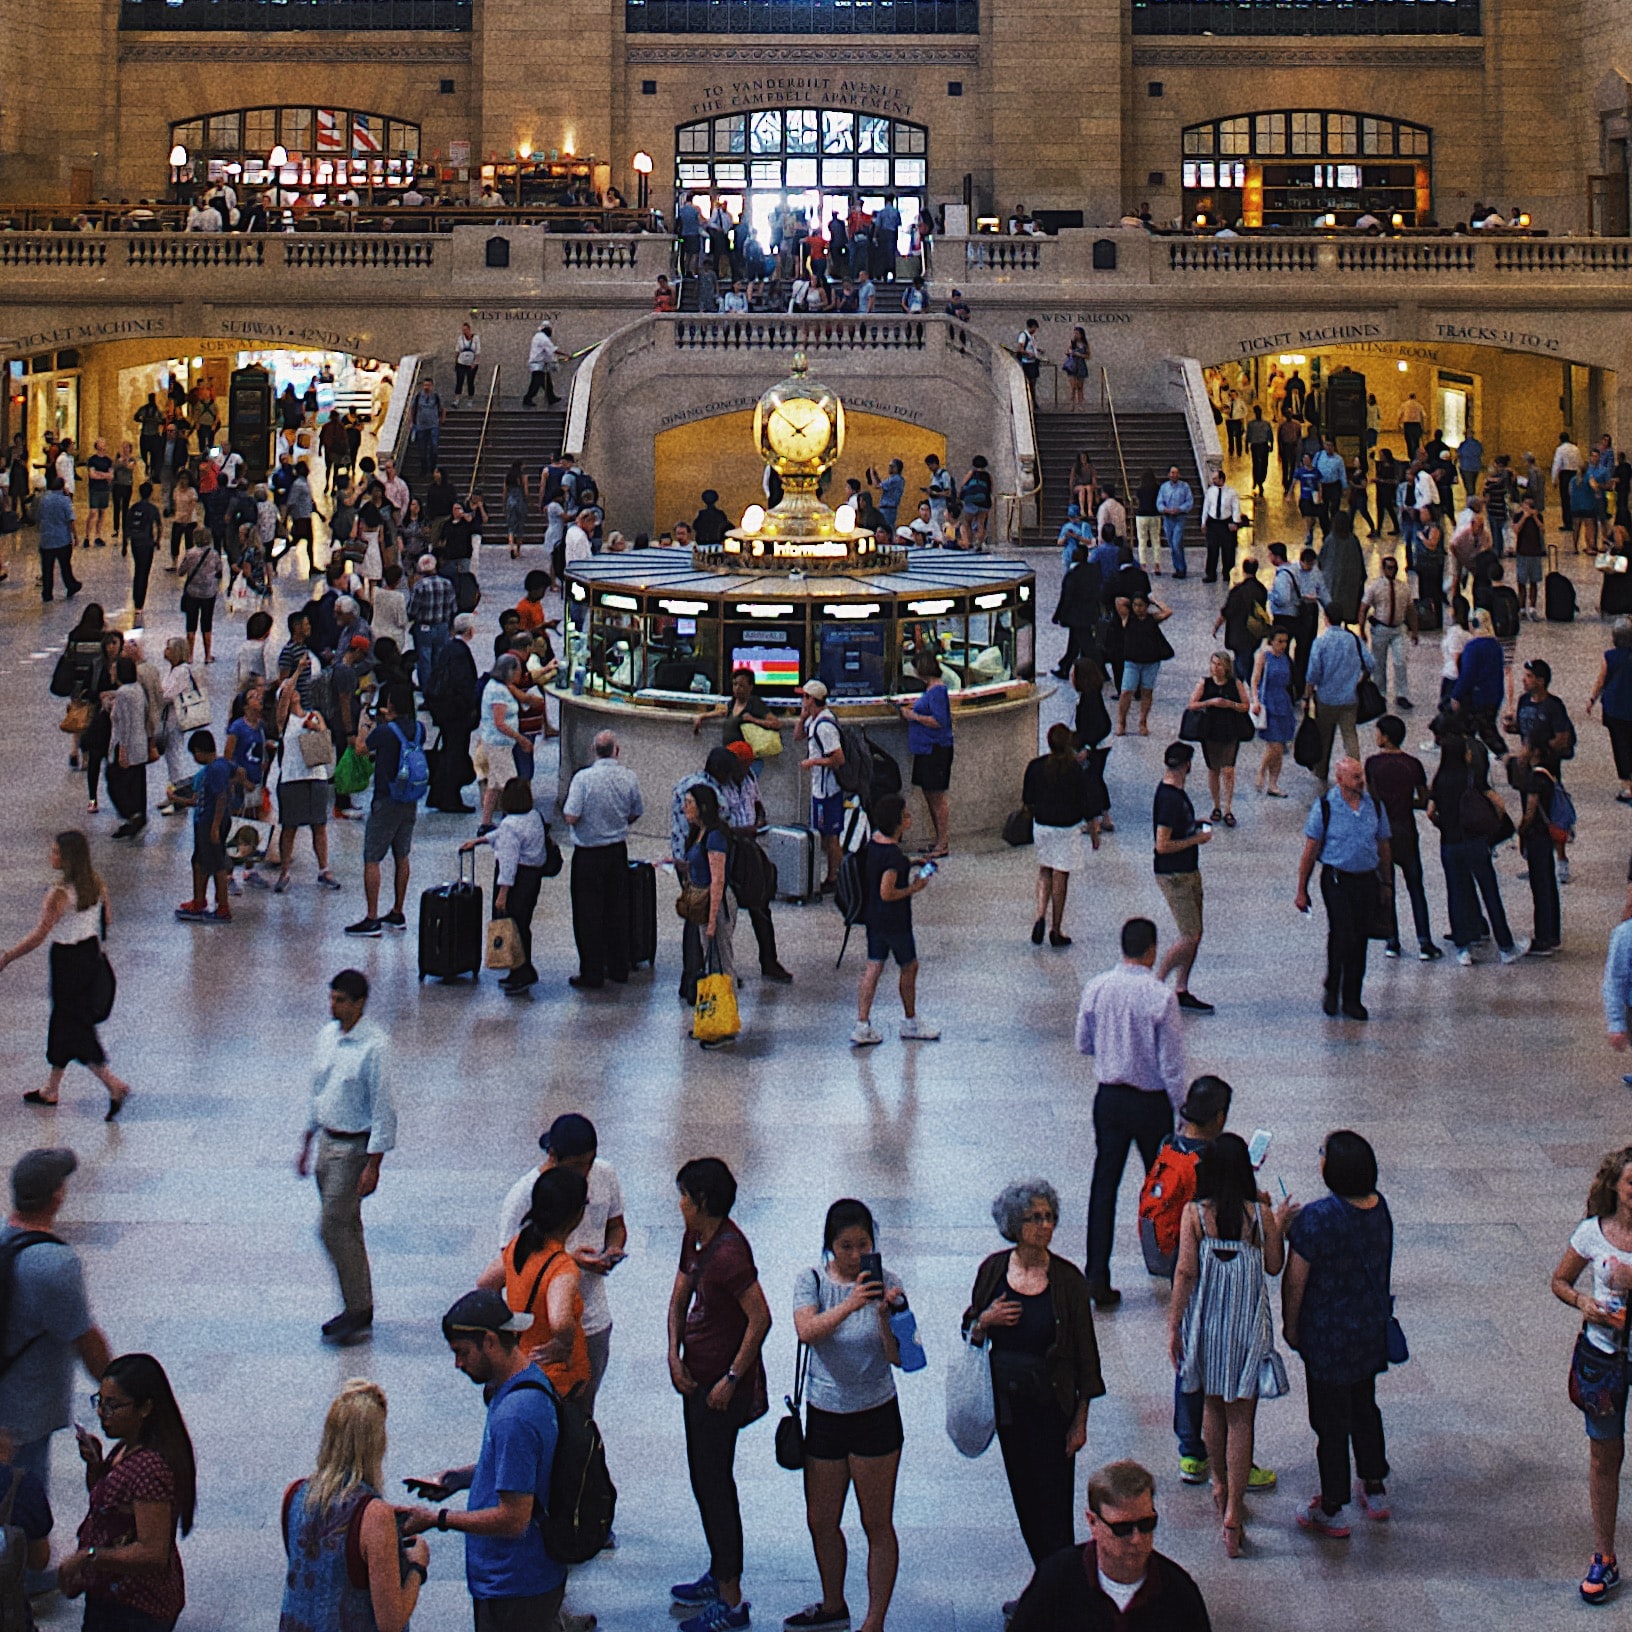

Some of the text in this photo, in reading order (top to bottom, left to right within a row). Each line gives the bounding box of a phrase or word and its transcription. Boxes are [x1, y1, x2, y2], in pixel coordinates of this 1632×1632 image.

[703, 77, 903, 99] TO VANDERBILT AVENUE
[692, 90, 914, 116] THE CAMPBELL APARTMENT
[1042, 313, 1132, 323] WEST BALCONY
[17, 320, 165, 350] TICKET MACHINES
[221, 320, 286, 337] SUBWAY
[299, 327, 340, 346] 42ND
[1239, 324, 1380, 353] TICKET MACHINES
[1436, 324, 1498, 341] TRACKS
[1519, 332, 1541, 348] TO
